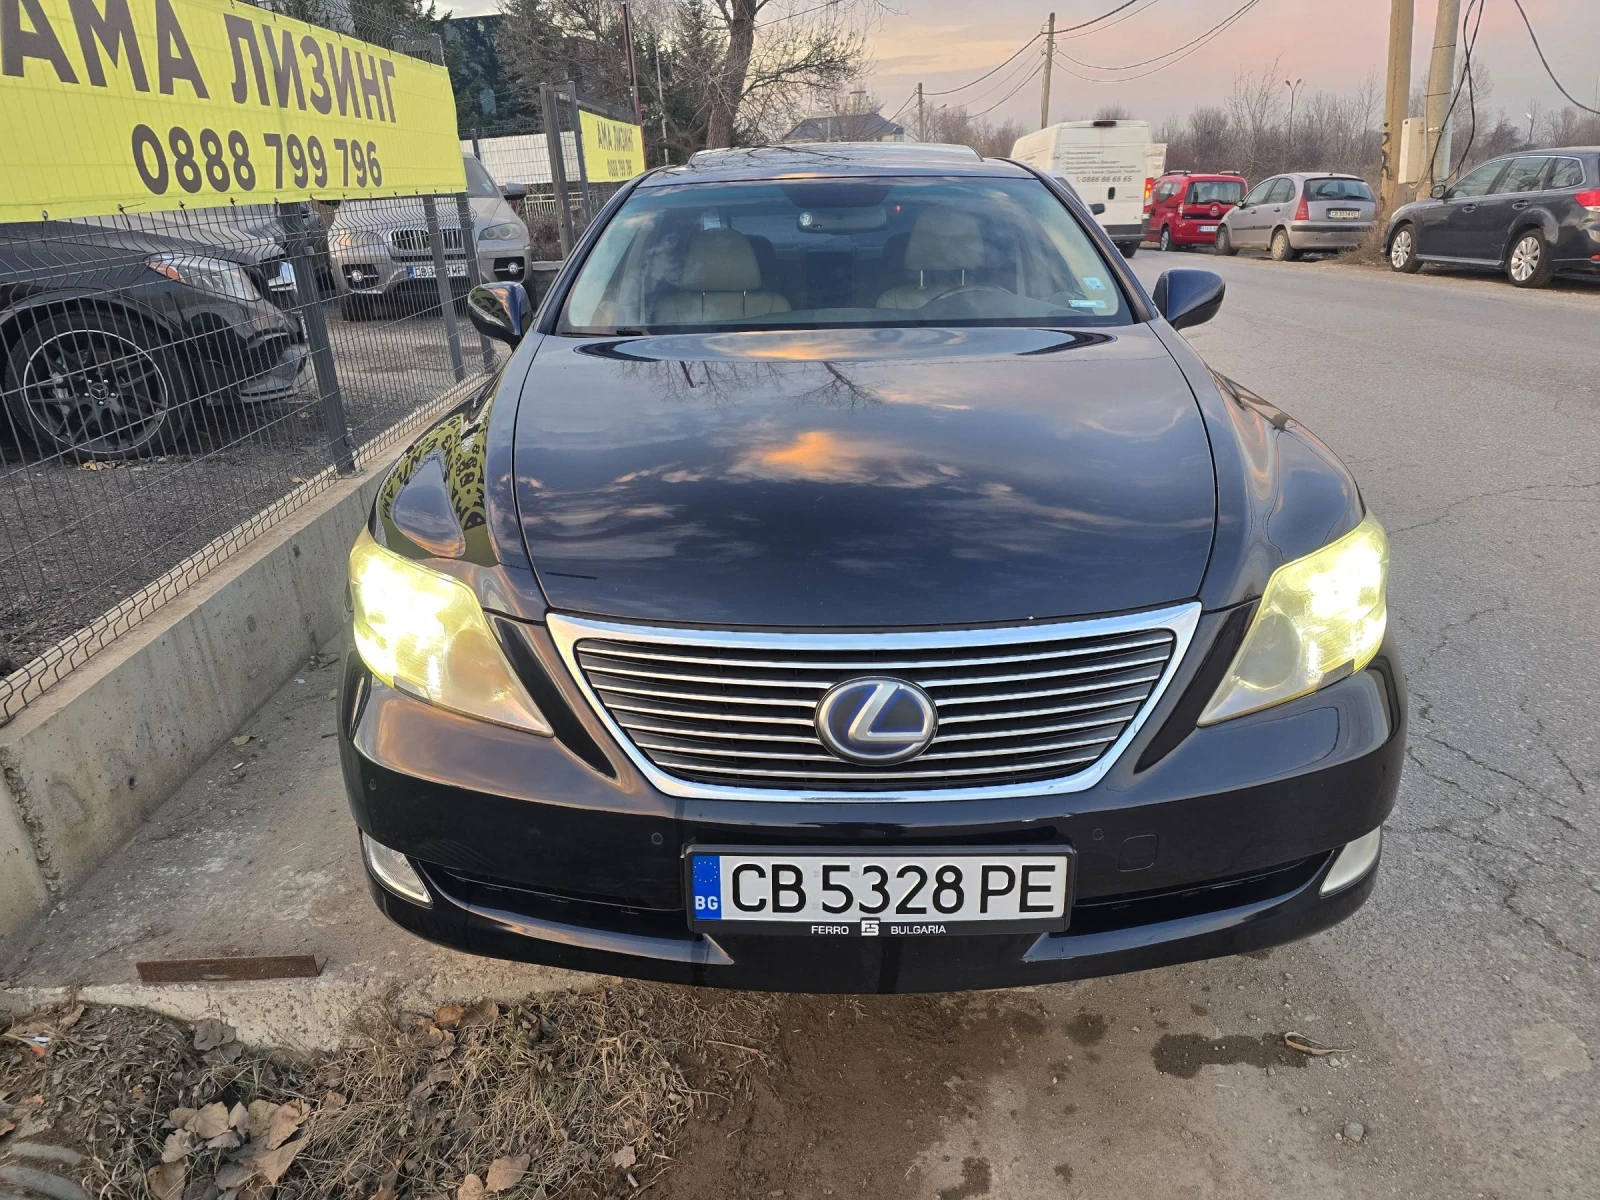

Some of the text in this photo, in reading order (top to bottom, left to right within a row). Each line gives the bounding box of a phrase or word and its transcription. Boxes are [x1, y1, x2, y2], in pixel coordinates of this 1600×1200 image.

[0, 0, 397, 123] АМА ЛИЗИНГ
[131, 124, 382, 195] 0888 799 796
[694, 895, 719, 911] BG
[731, 863, 1056, 914] CB 5328 PE
[811, 925, 850, 935] FERRO
[890, 924, 947, 935] BULGARIA
